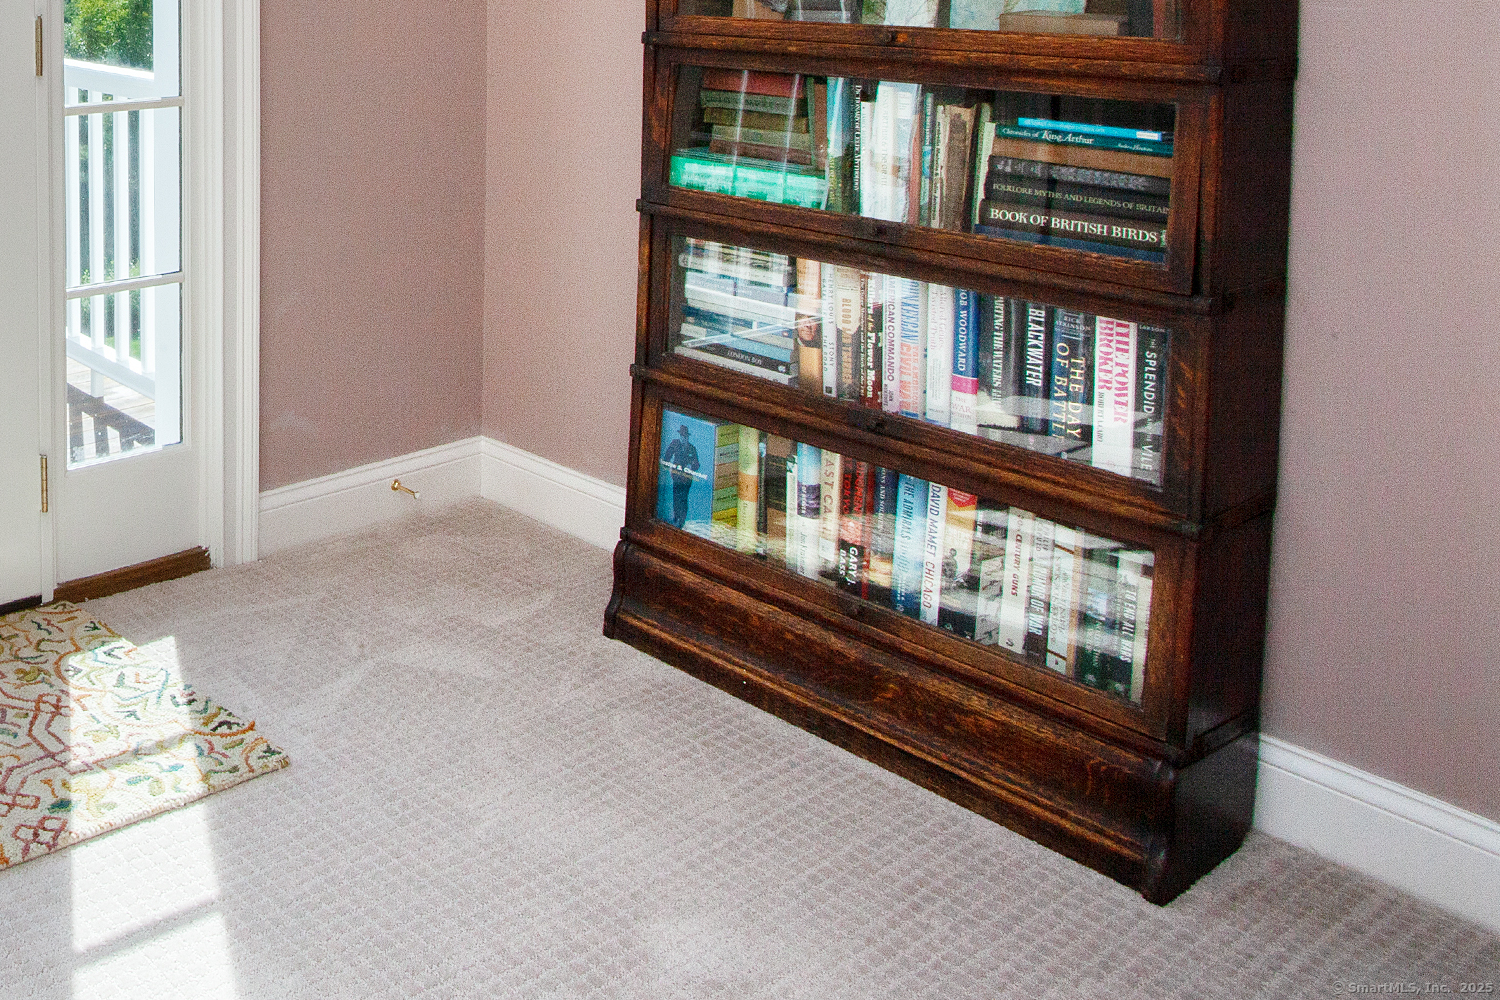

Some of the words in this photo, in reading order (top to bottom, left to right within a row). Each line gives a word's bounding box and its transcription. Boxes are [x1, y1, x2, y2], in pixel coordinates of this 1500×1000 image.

[1041, 130, 1063, 143] King
[1063, 131, 1095, 145] Arthur
[992, 183, 1033, 196] FOLKLORE
[1034, 189, 1063, 200] MYTHS
[1064, 192, 1083, 202] AND
[1084, 194, 1122, 208] LEGENDS
[1122, 201, 1135, 210] OF
[989, 208, 1028, 224] BOOK
[1029, 214, 1049, 227] OF
[1050, 216, 1108, 236] BRITISH
[1110, 226, 1159, 243] BIRDS
[866, 278, 875, 315] Killers
[888, 276, 896, 323] AMERICAN
[901, 280, 920, 302] OHN
[959, 290, 968, 306] OB
[842, 298, 852, 325] BLOOD
[900, 301, 919, 340] KEEGAN
[866, 331, 875, 369] Flower
[886, 324, 896, 382] COMMANDO
[957, 310, 968, 372] WOODWARD
[993, 331, 1004, 350] THE
[1025, 308, 1045, 387] BLACKWATER
[1056, 342, 1070, 368] OF
[1098, 318, 1114, 392] BROKER
[1114, 320, 1130, 360] THE
[901, 342, 912, 377] CIVIL
[992, 350, 1003, 387] WATERS
[1069, 357, 1086, 394] THE
[866, 369, 875, 398] Moon
[900, 380, 912, 411] WAR
[1113, 360, 1130, 424] POWER
[1144, 350, 1158, 414] SPLENDID
[1067, 401, 1084, 438] DAY
[824, 455, 835, 490] AST
[1140, 445, 1154, 471] VILE
[843, 473, 852, 515] TOKYO
[854, 462, 865, 515] UDGMENT
[904, 481, 915, 498] THE
[929, 484, 941, 515] DAVID
[901, 498, 914, 540] ADMIRALS
[926, 517, 938, 557] MAMET
[1012, 533, 1023, 571] CENTURY
[839, 549, 847, 576] BASS
[848, 547, 859, 577] GARY
[844, 577, 856, 586] J.
[922, 561, 935, 609] CHICAGO
[1011, 572, 1020, 597] GUNS
[1031, 567, 1047, 598] RUMOR
[1125, 590, 1137, 601] TO
[1030, 598, 1044, 612] OF
[1123, 602, 1136, 620] END
[1028, 613, 1043, 636] WAR
[1121, 620, 1135, 638] ALL
[1120, 639, 1133, 663] WARS
